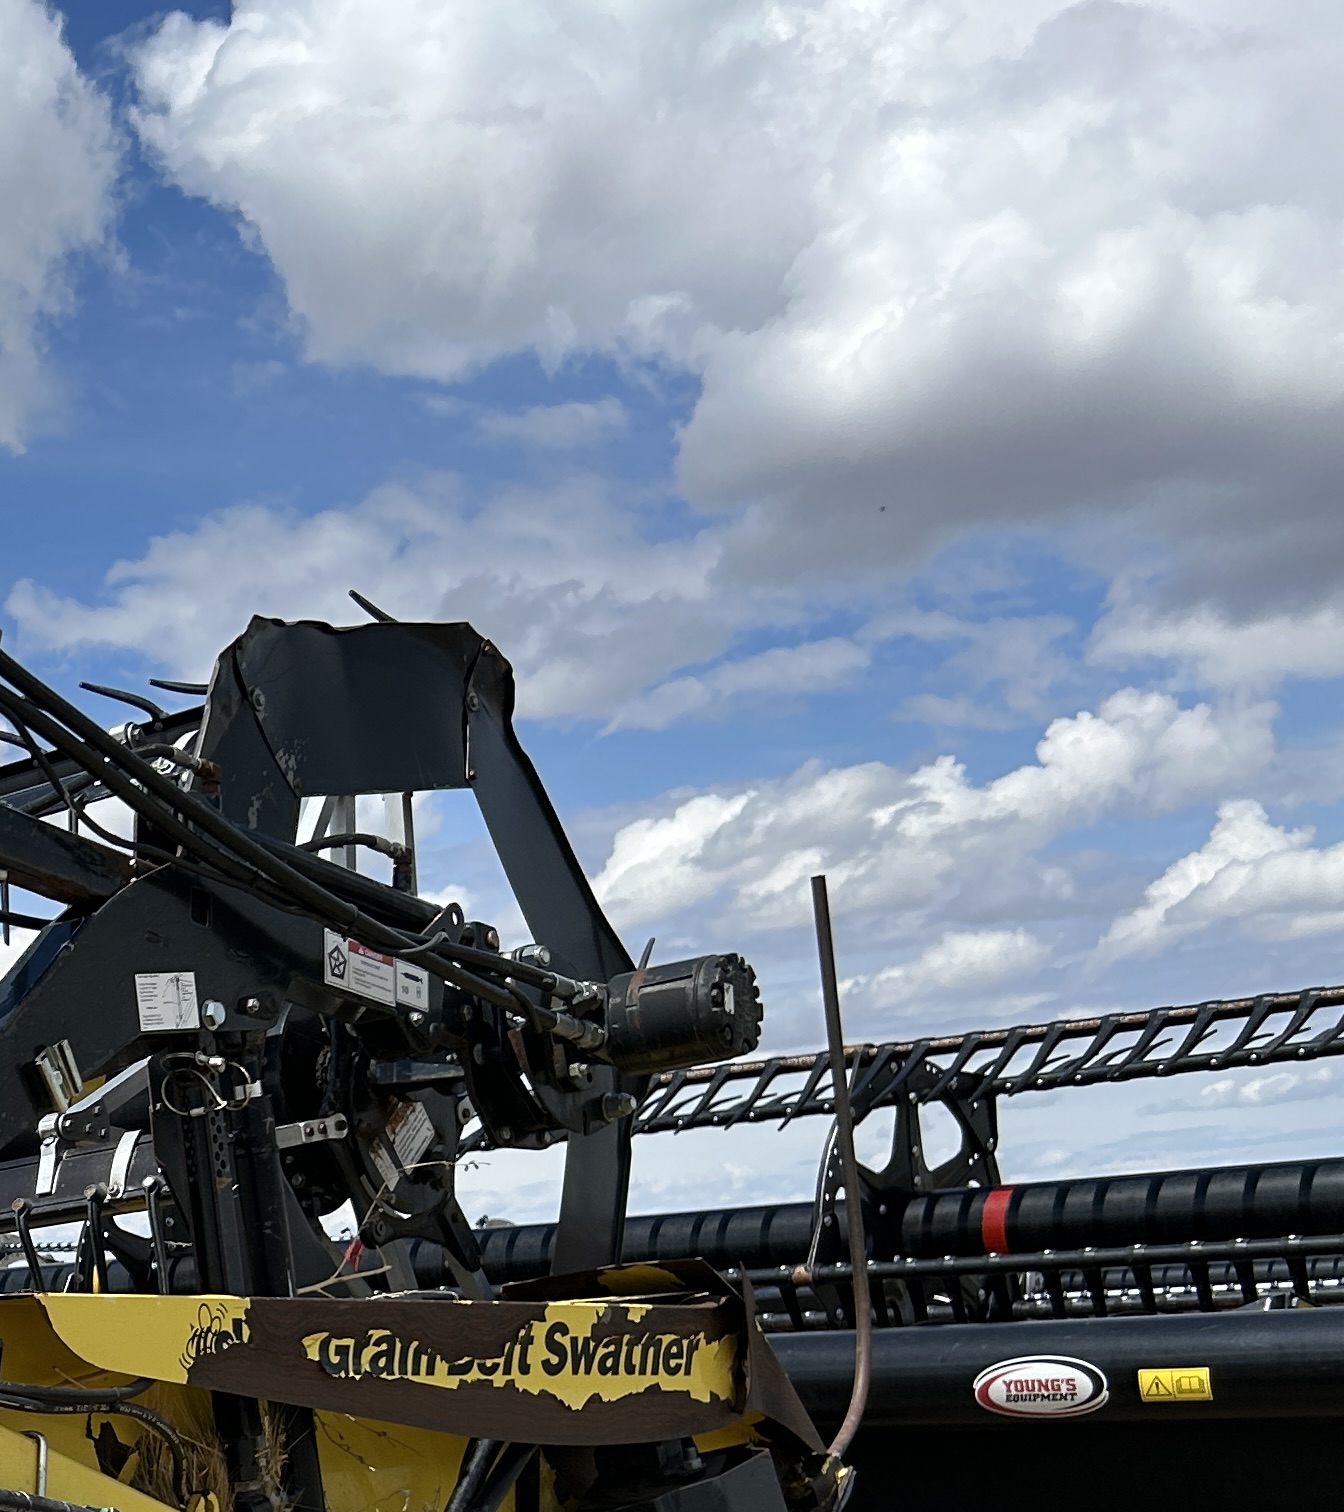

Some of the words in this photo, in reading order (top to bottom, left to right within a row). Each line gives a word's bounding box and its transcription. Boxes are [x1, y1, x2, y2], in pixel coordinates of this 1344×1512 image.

[541, 1321, 699, 1376] Swather
[1002, 1378, 1077, 1393] YOUNG'S
[1005, 1392, 1078, 1403] EQUIPMENT
